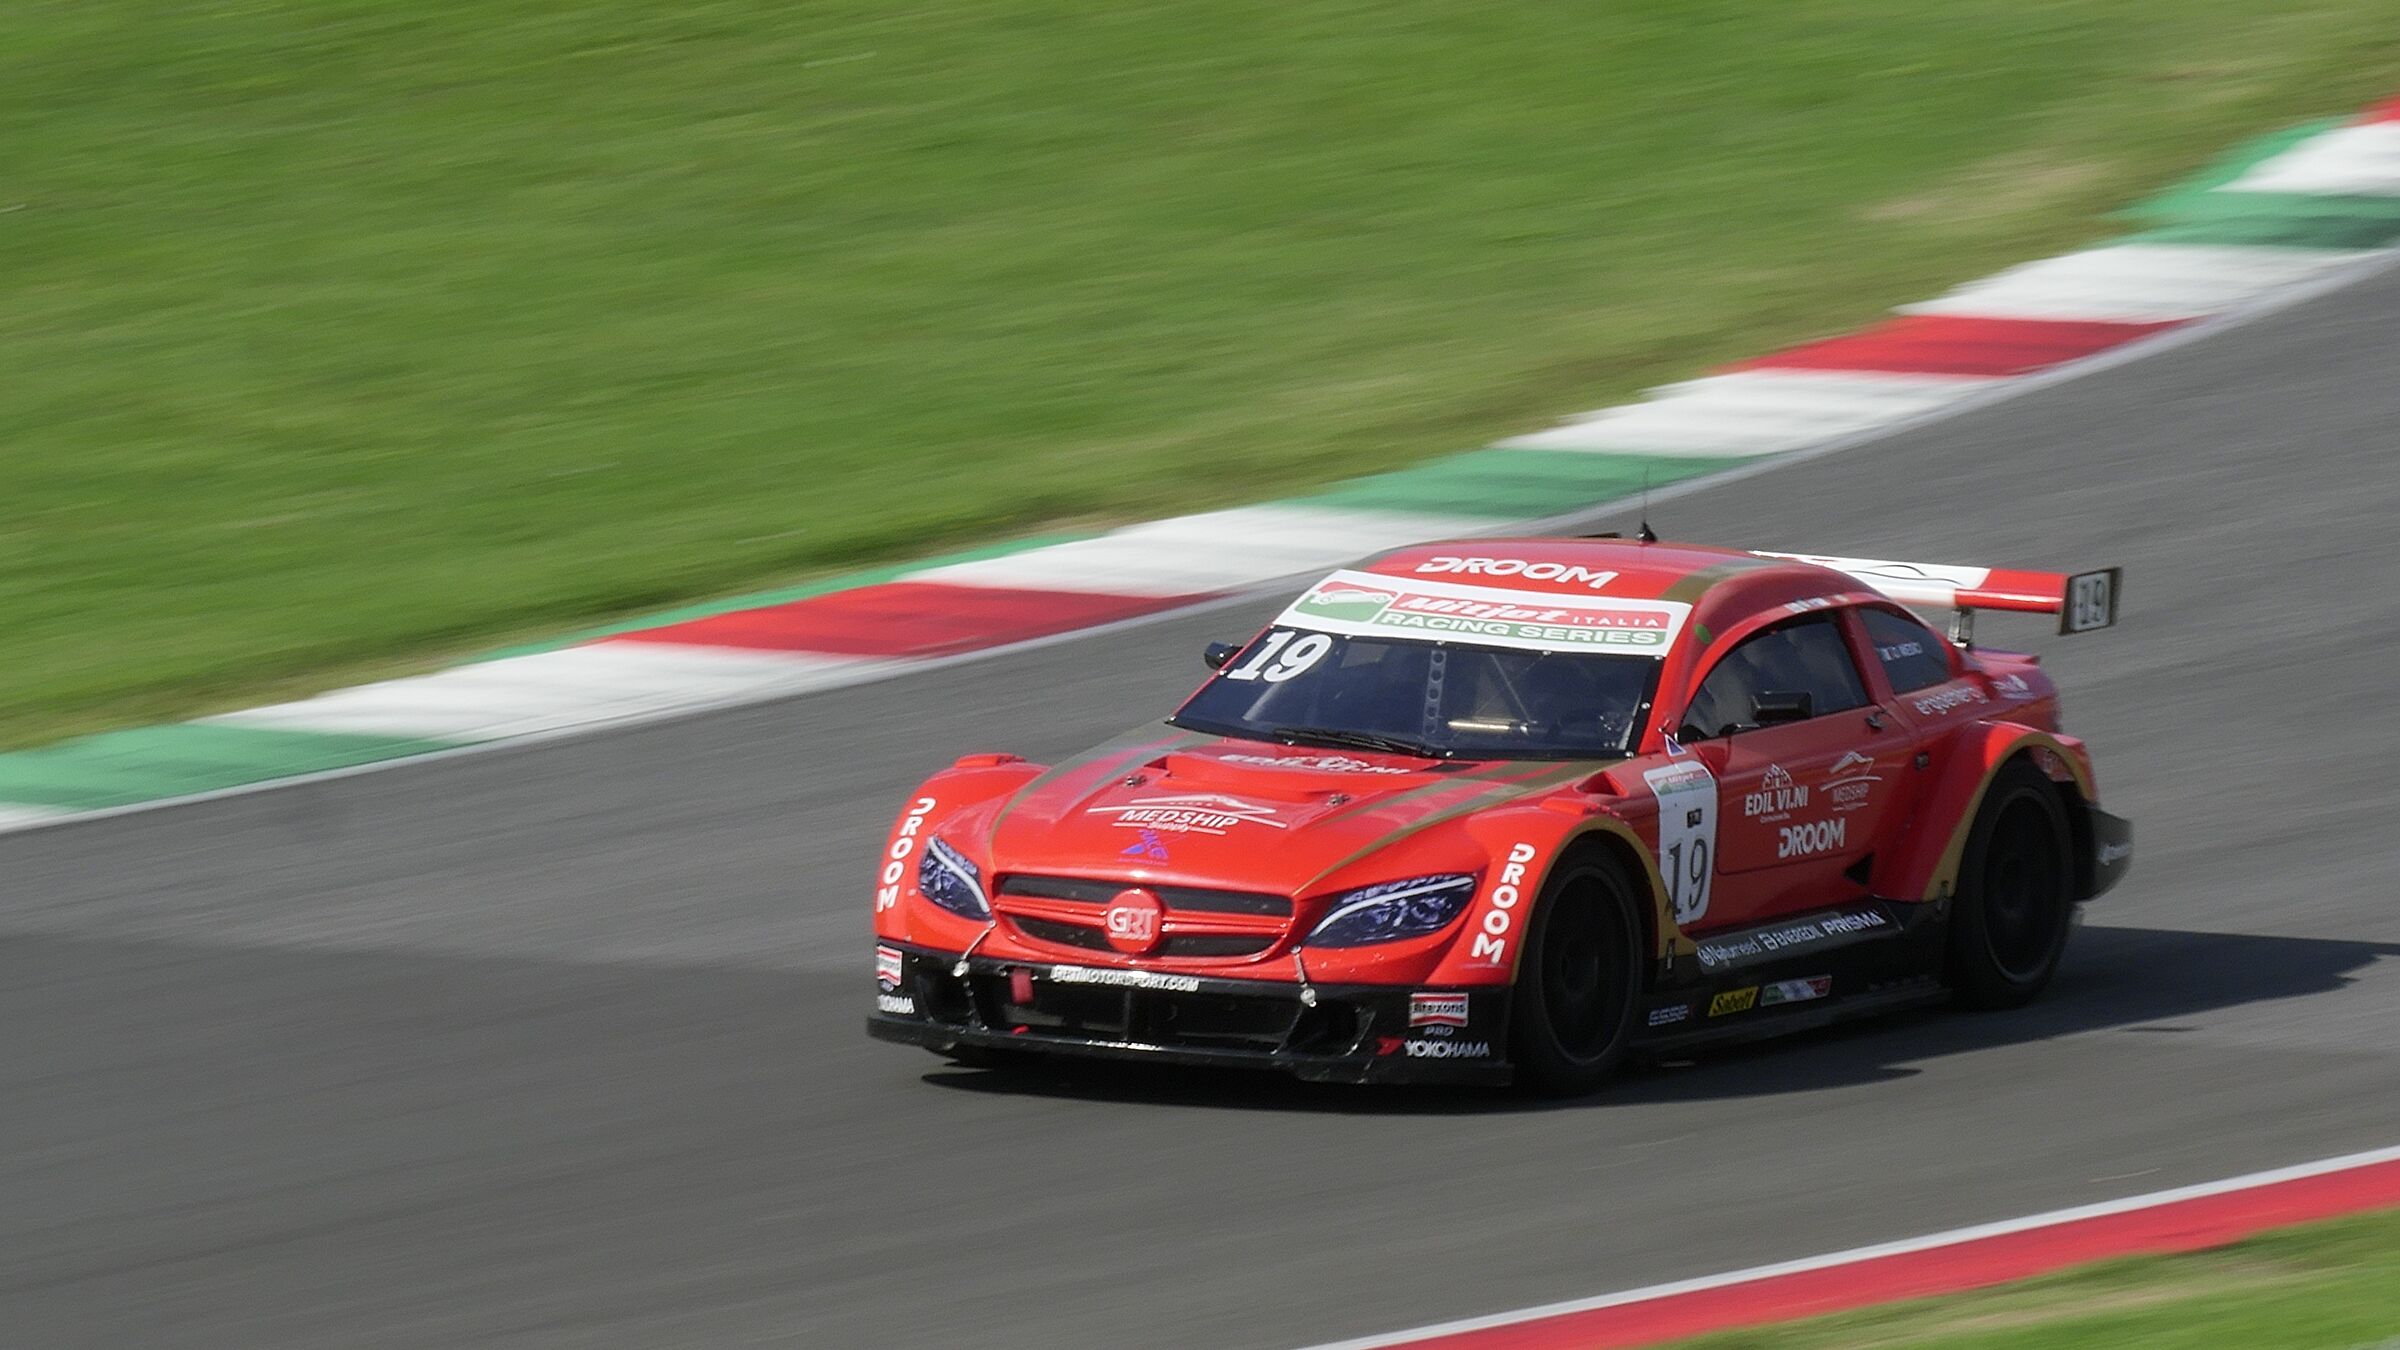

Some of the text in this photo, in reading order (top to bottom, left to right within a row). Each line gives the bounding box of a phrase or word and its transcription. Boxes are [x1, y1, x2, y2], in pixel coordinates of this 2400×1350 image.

[1415, 556, 1619, 589] DROOM
[1378, 613, 1660, 646] RACING SERIES
[1570, 616, 1661, 628] ITALIA
[1227, 631, 1333, 683] 19
[1745, 785, 1809, 816] EDIL VI.NI
[1119, 809, 1239, 828] MEDSHIP
[1778, 817, 1846, 858] DROOM
[876, 797, 935, 912] DROOM
[1668, 838, 1708, 916] 19
[1471, 842, 1536, 964] DROOM
[1819, 910, 1887, 935] PRISMA
[1404, 1040, 1490, 1057] YOKOHAMA
